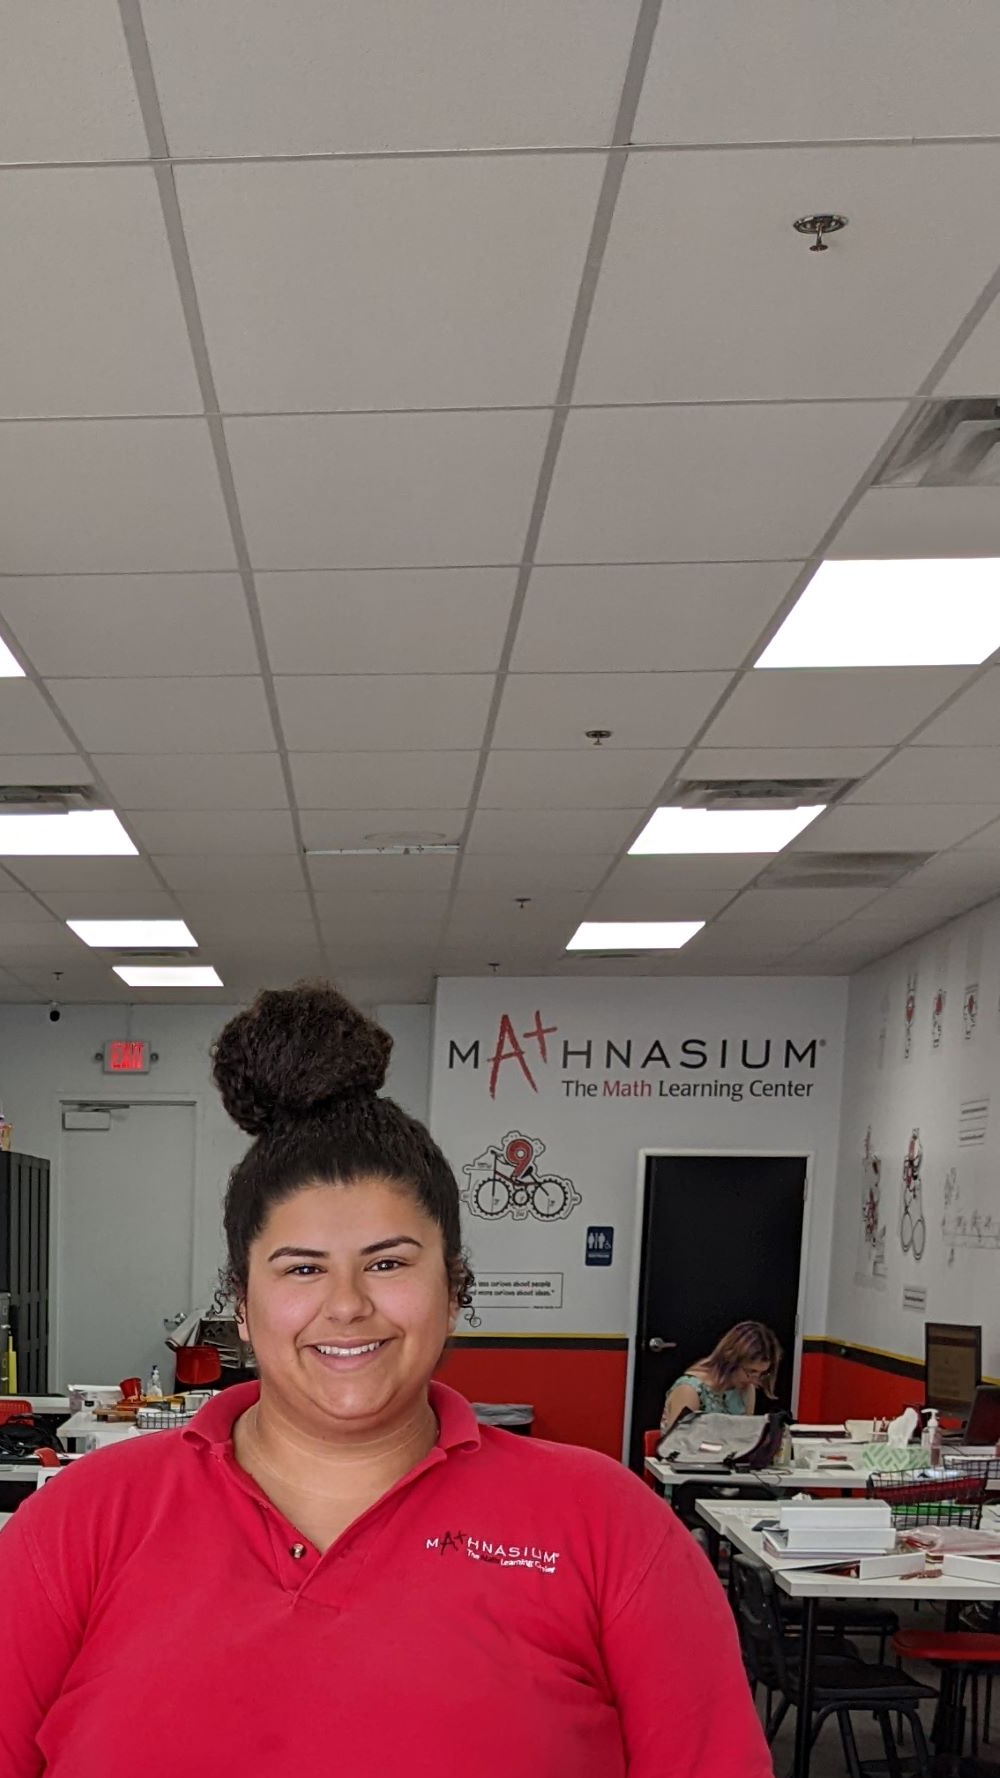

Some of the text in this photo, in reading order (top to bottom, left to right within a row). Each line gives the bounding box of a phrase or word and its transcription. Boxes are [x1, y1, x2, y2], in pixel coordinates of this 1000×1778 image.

[562, 1079, 814, 1101] The Math Learning Center
[467, 1548, 480, 1560] The
